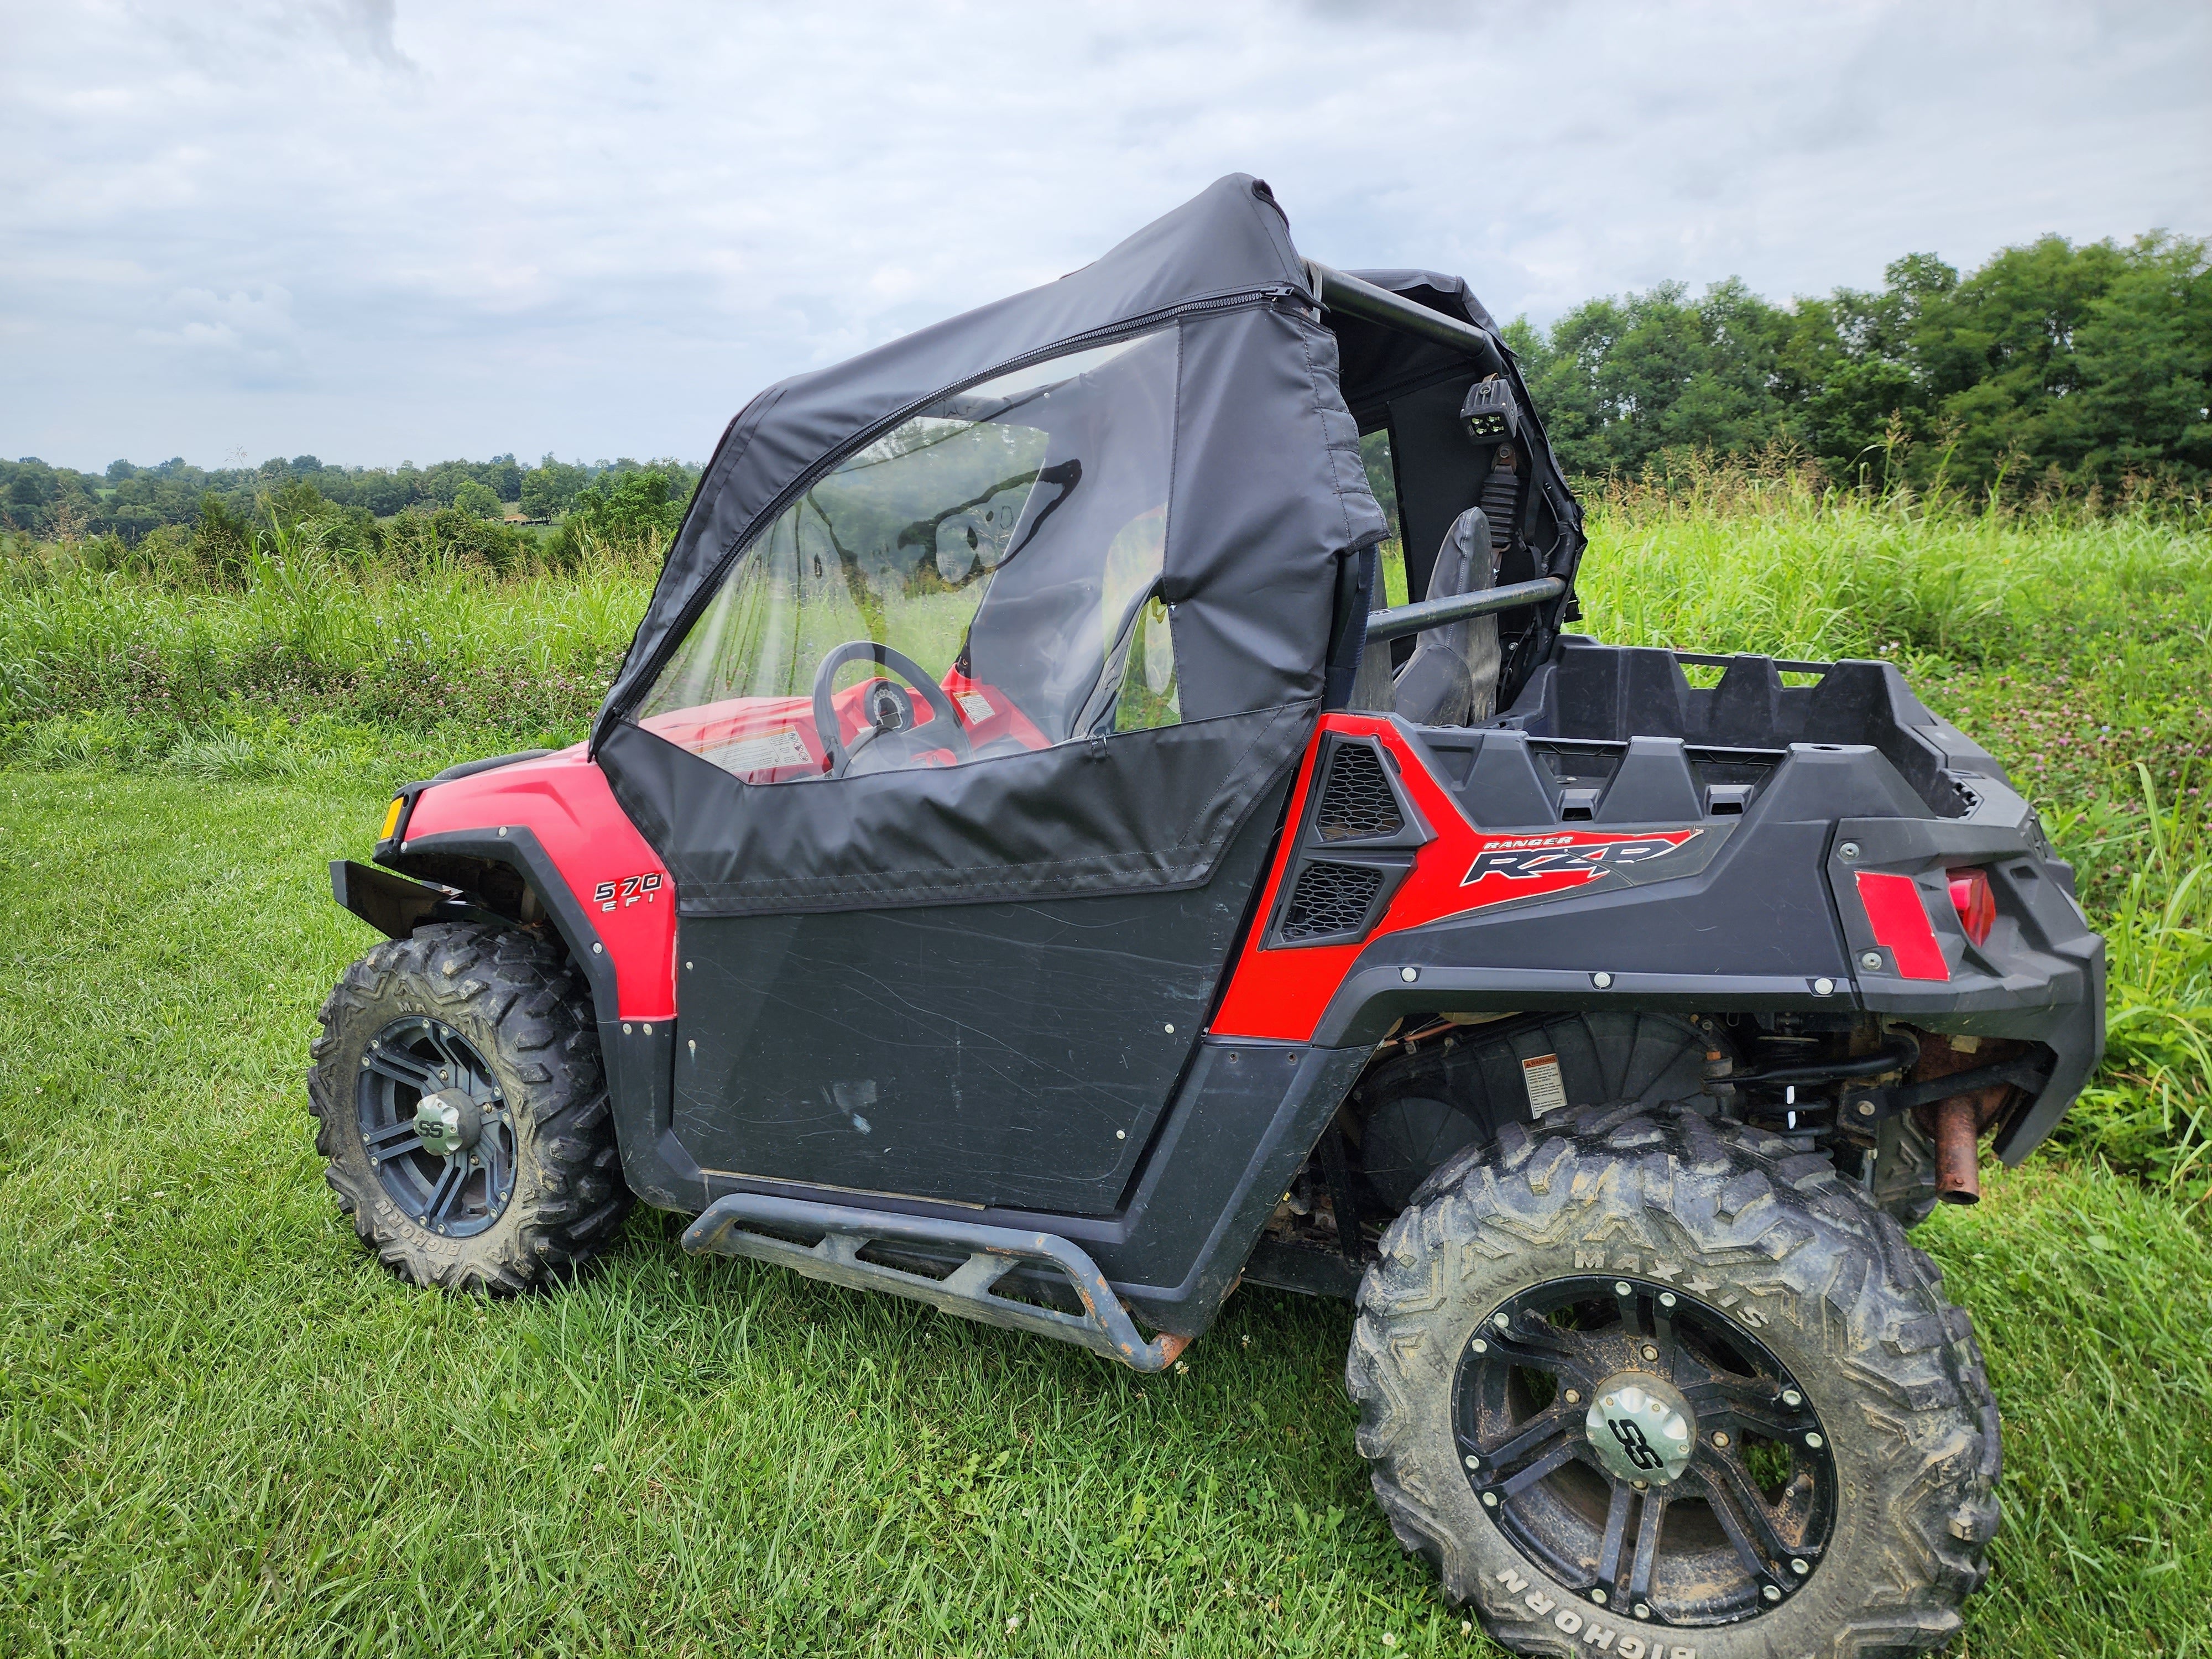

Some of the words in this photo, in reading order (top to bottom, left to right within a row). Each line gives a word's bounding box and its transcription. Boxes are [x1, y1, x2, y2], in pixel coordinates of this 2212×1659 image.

[1483, 836, 1574, 850] RANGER
[593, 873, 664, 902] 570
[601, 893, 654, 912] EFI
[1531, 1057, 1556, 1066] WARNING
[419, 1120, 444, 1138] SS
[375, 1199, 462, 1256] BIGHORN
[1574, 1251, 1769, 1328] MAXXIS
[1608, 1419, 1663, 1470] SS
